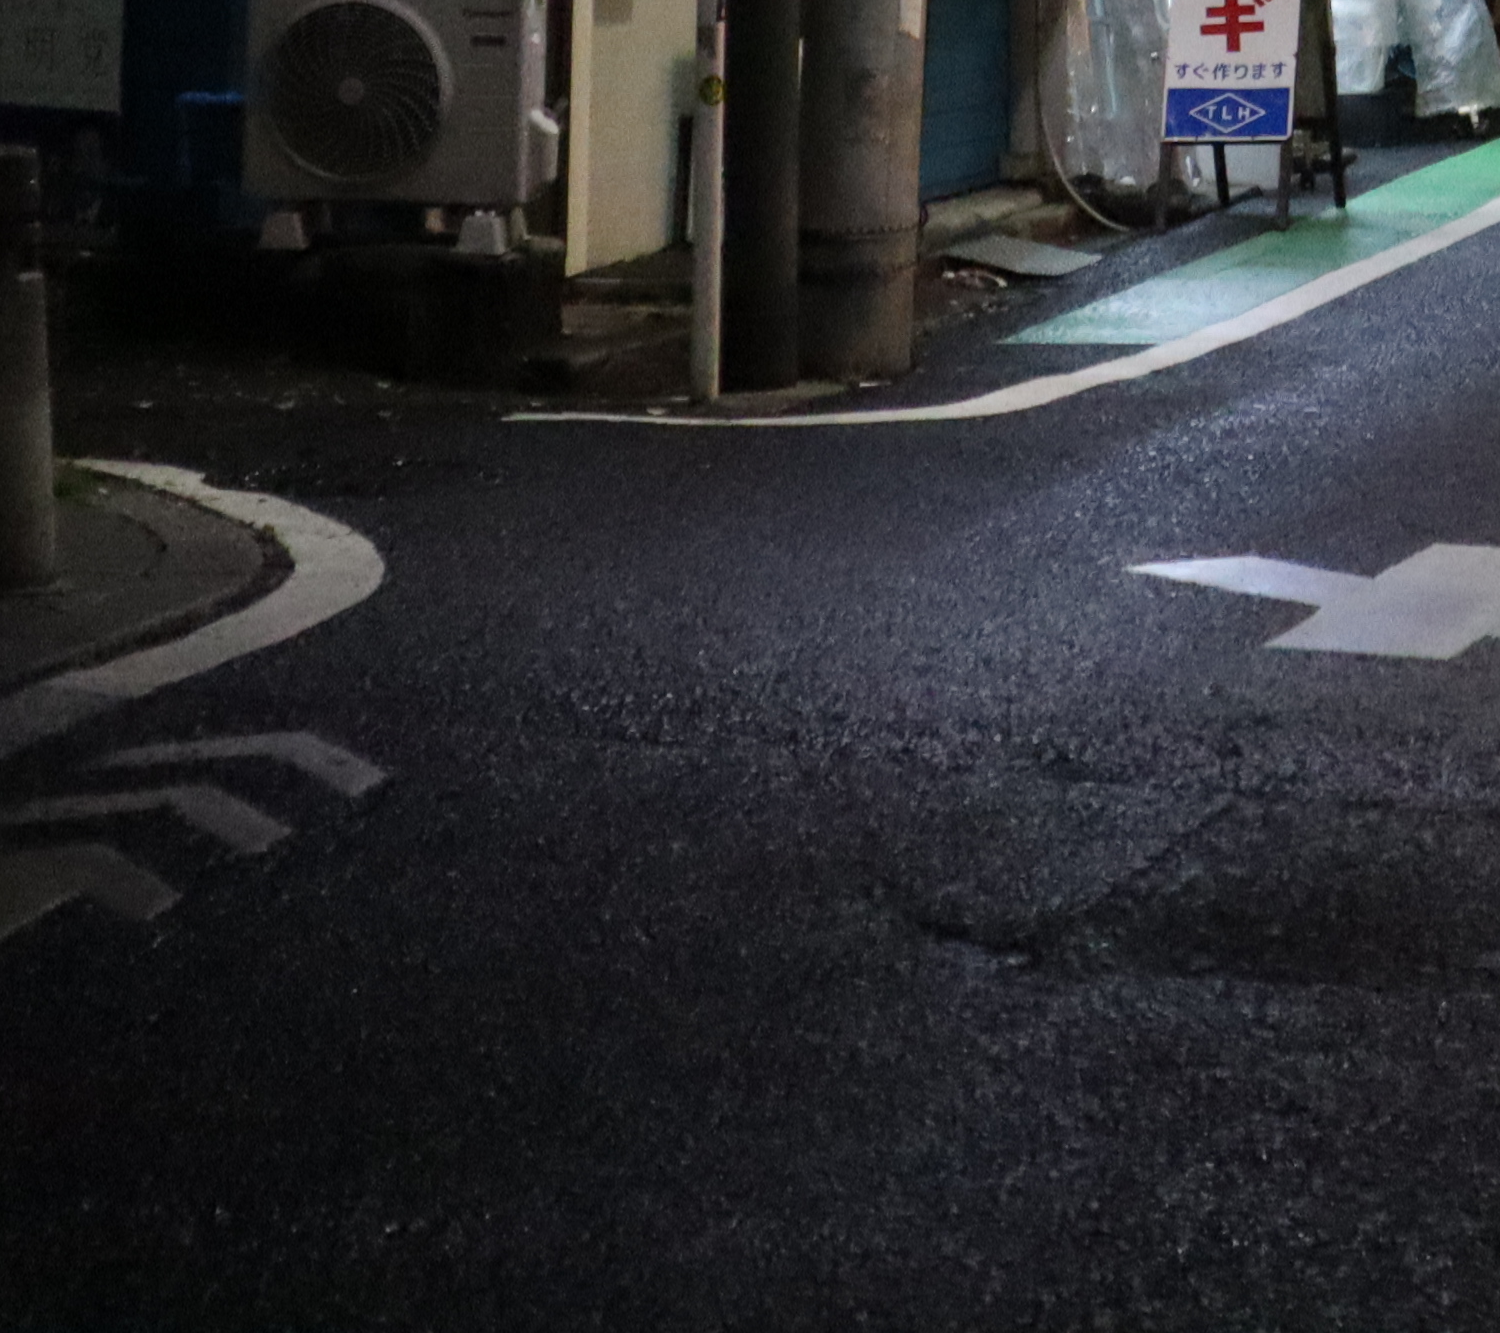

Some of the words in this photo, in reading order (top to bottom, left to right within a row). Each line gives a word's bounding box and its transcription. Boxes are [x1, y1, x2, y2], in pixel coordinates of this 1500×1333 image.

[1174, 60, 1288, 81] すぐ作ります
[1205, 106, 1251, 122] TLH
